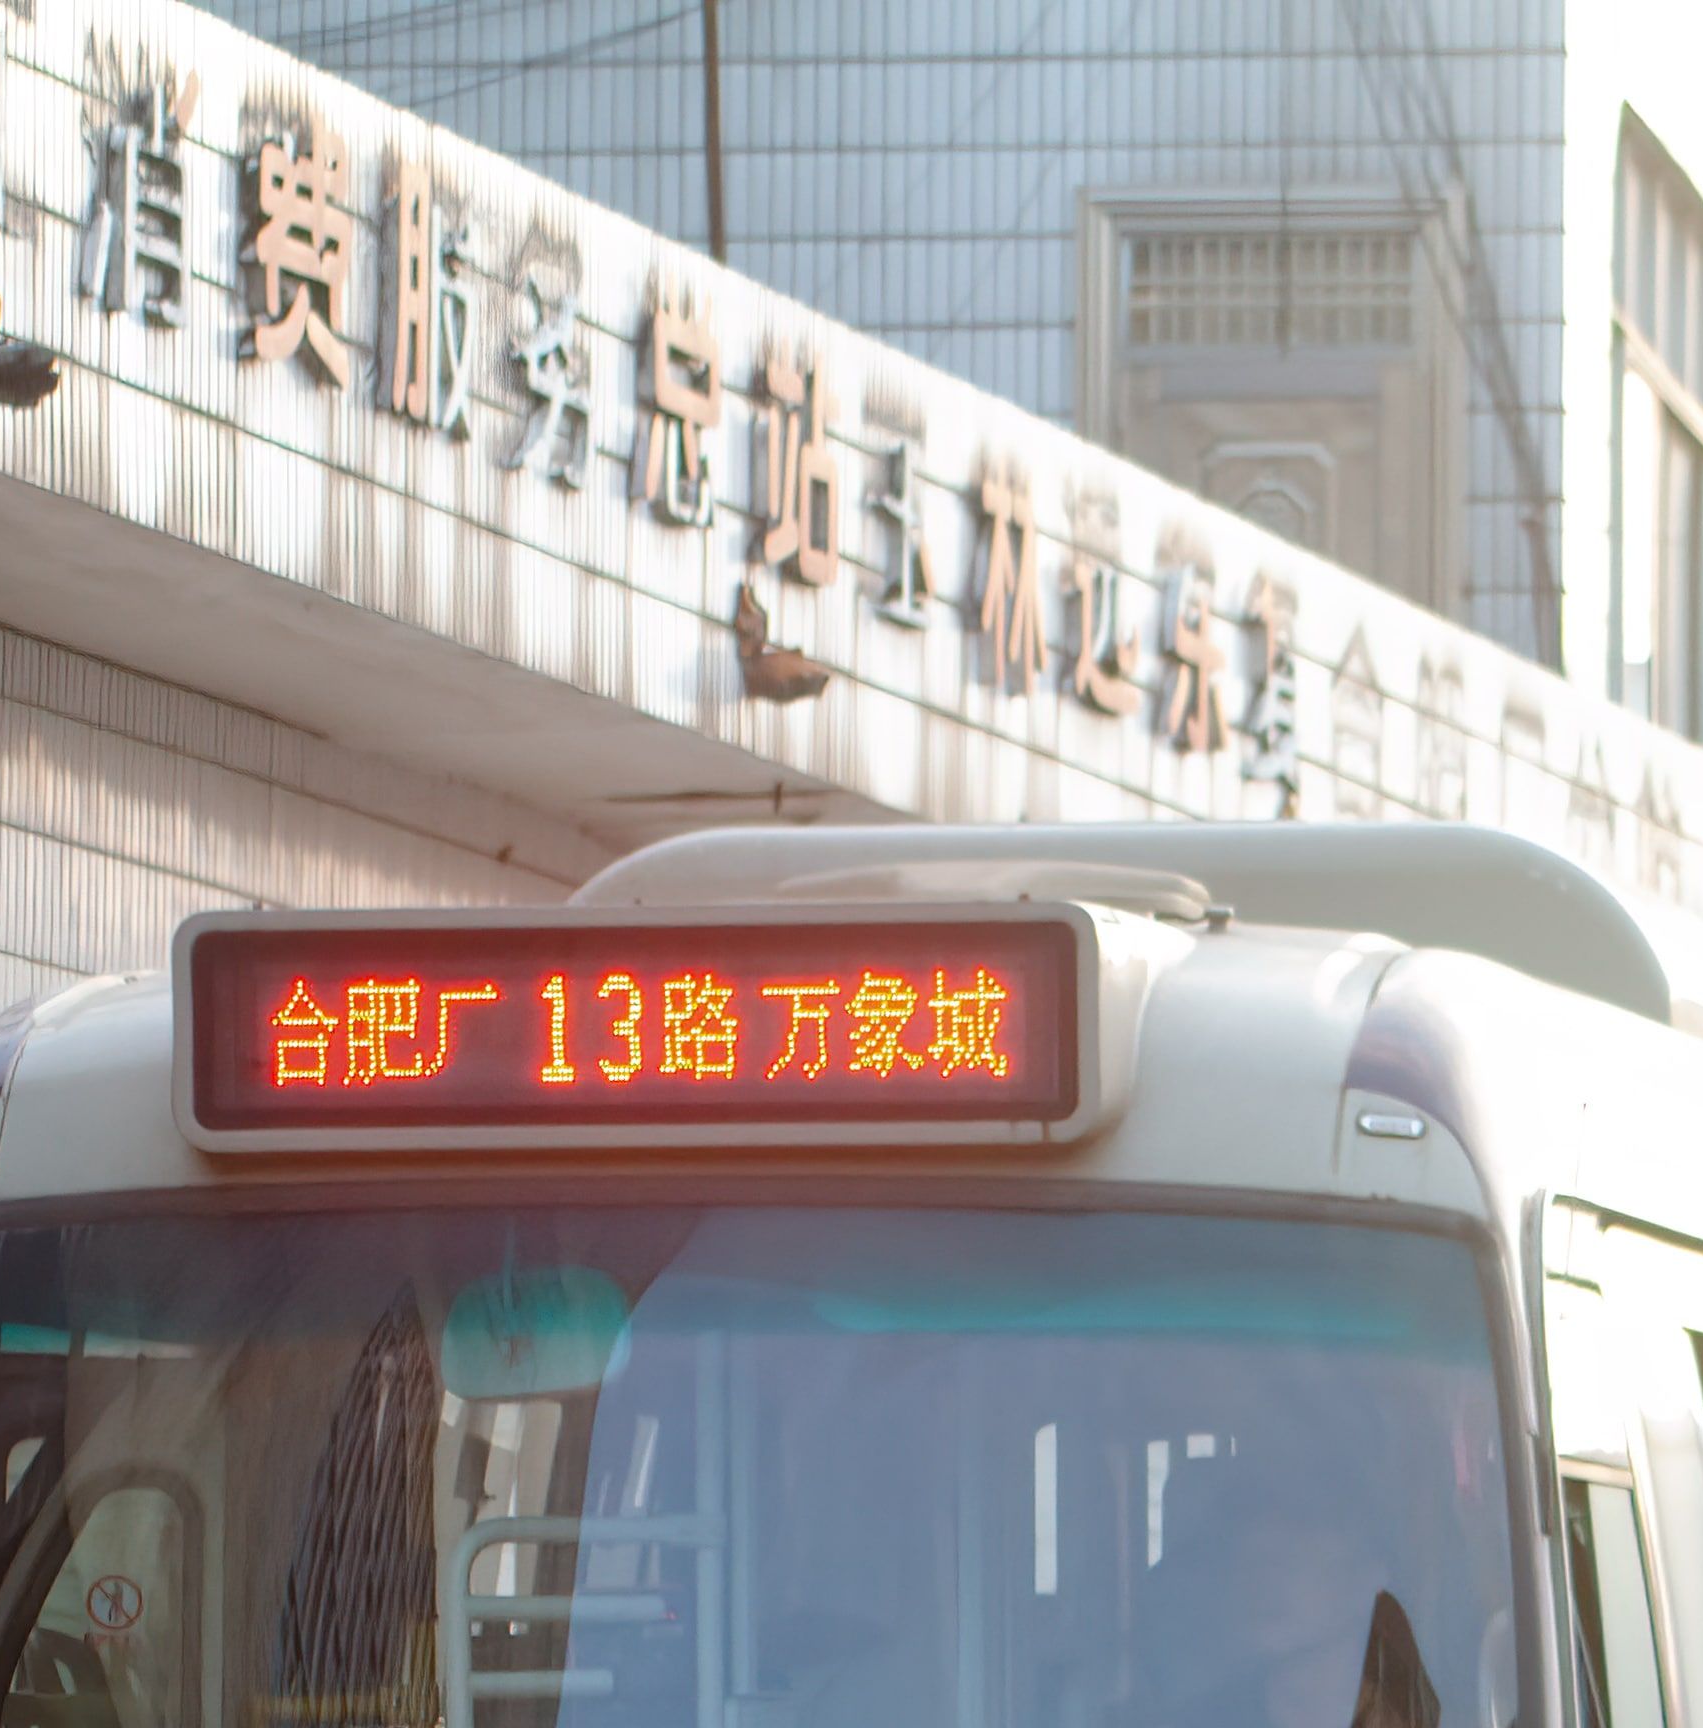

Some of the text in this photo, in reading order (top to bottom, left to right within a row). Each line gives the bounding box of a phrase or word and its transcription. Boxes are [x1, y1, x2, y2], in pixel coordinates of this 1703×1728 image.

[271, 978, 499, 1088] 合肥厂
[761, 967, 1010, 1080] 万象城
